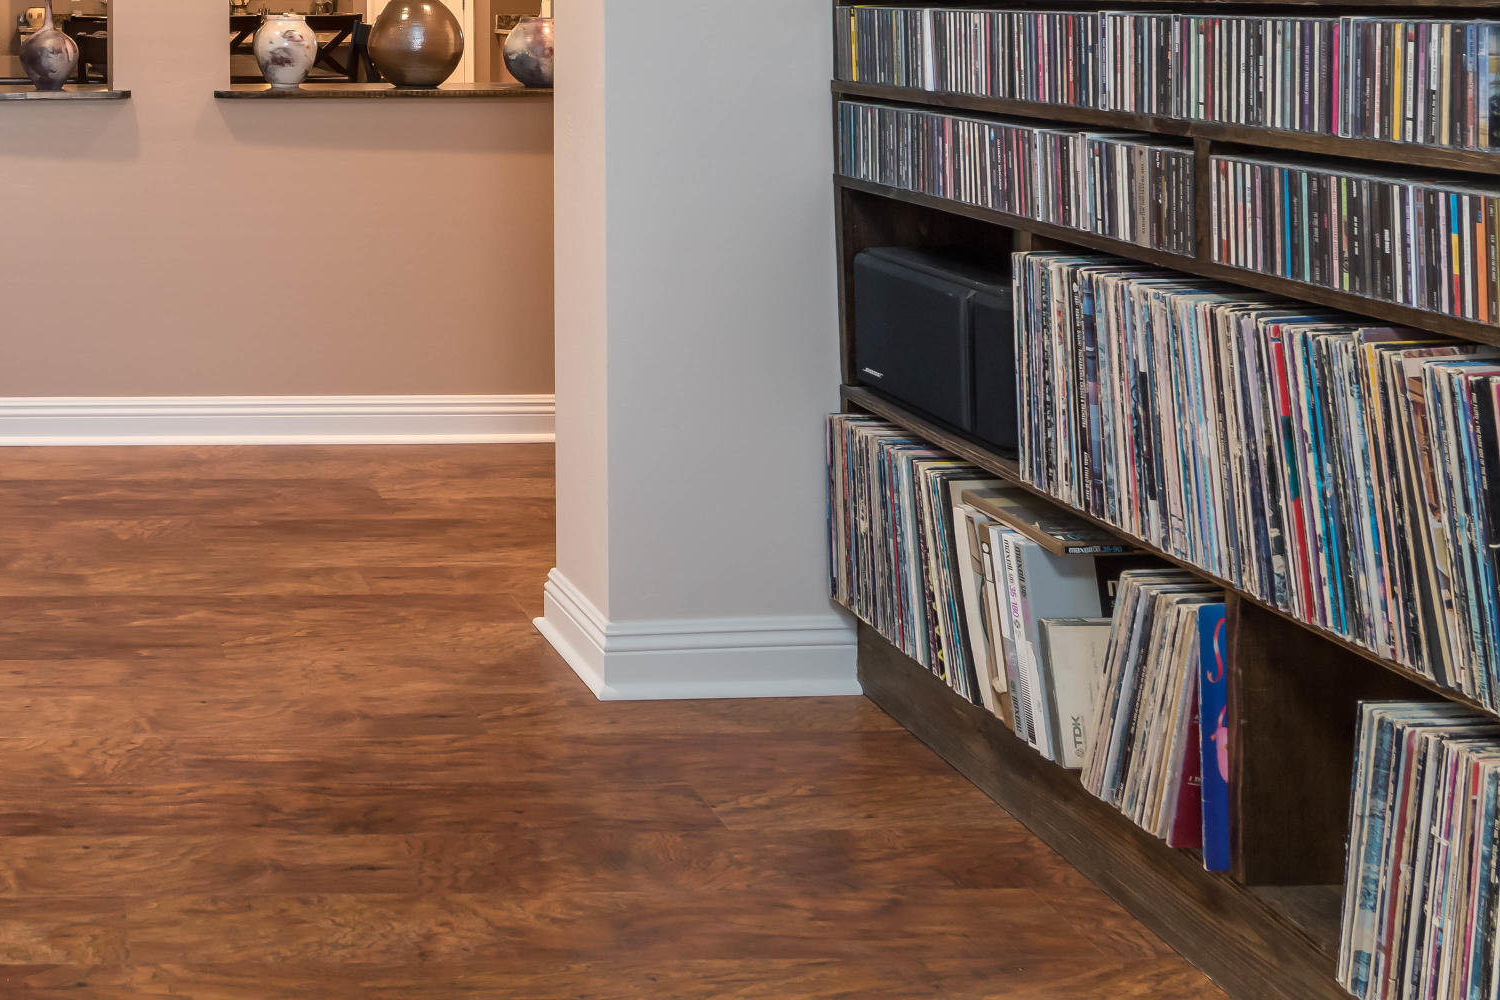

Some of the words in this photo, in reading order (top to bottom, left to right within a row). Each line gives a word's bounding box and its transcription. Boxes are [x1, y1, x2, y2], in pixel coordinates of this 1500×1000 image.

[1004, 539, 1013, 571] maxell
[1010, 585, 1019, 618] 35-180
[1015, 546, 1025, 582] maxell
[1071, 715, 1083, 747] TDK
